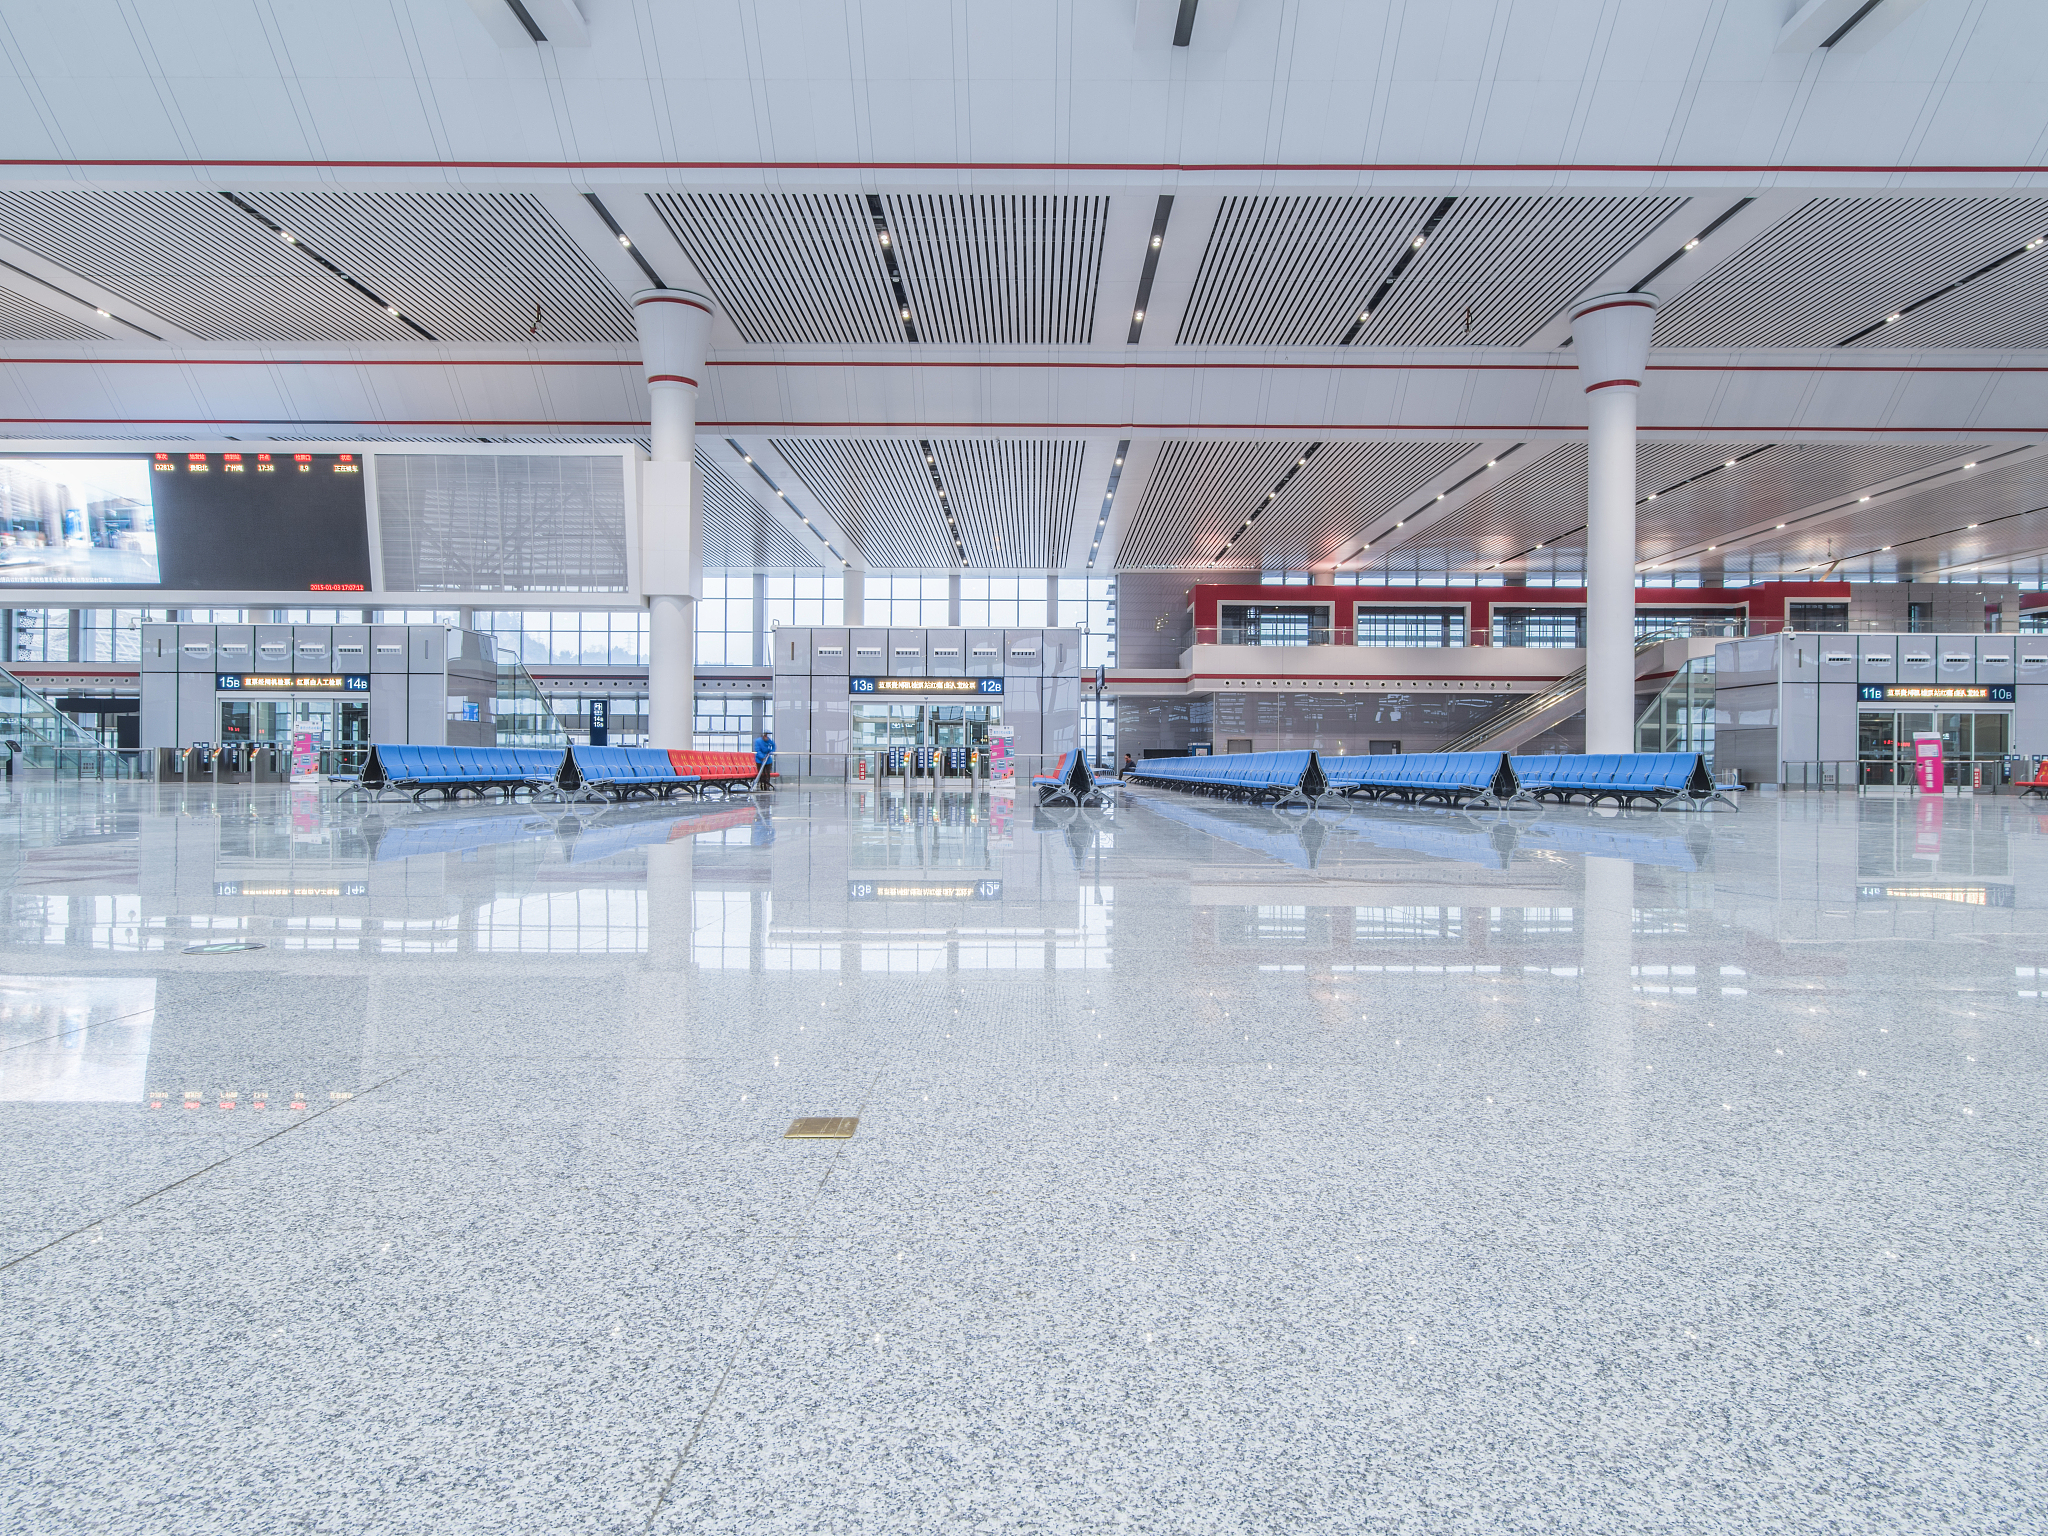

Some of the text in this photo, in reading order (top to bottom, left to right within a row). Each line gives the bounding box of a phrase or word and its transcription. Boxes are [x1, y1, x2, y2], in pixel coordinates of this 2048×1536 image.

[219, 676, 240, 688] 15B
[347, 677, 368, 689] 14B
[852, 679, 873, 691] 13B
[981, 680, 1002, 692] 12B
[1862, 687, 1882, 699] 11B
[1991, 688, 2012, 700] 10B
